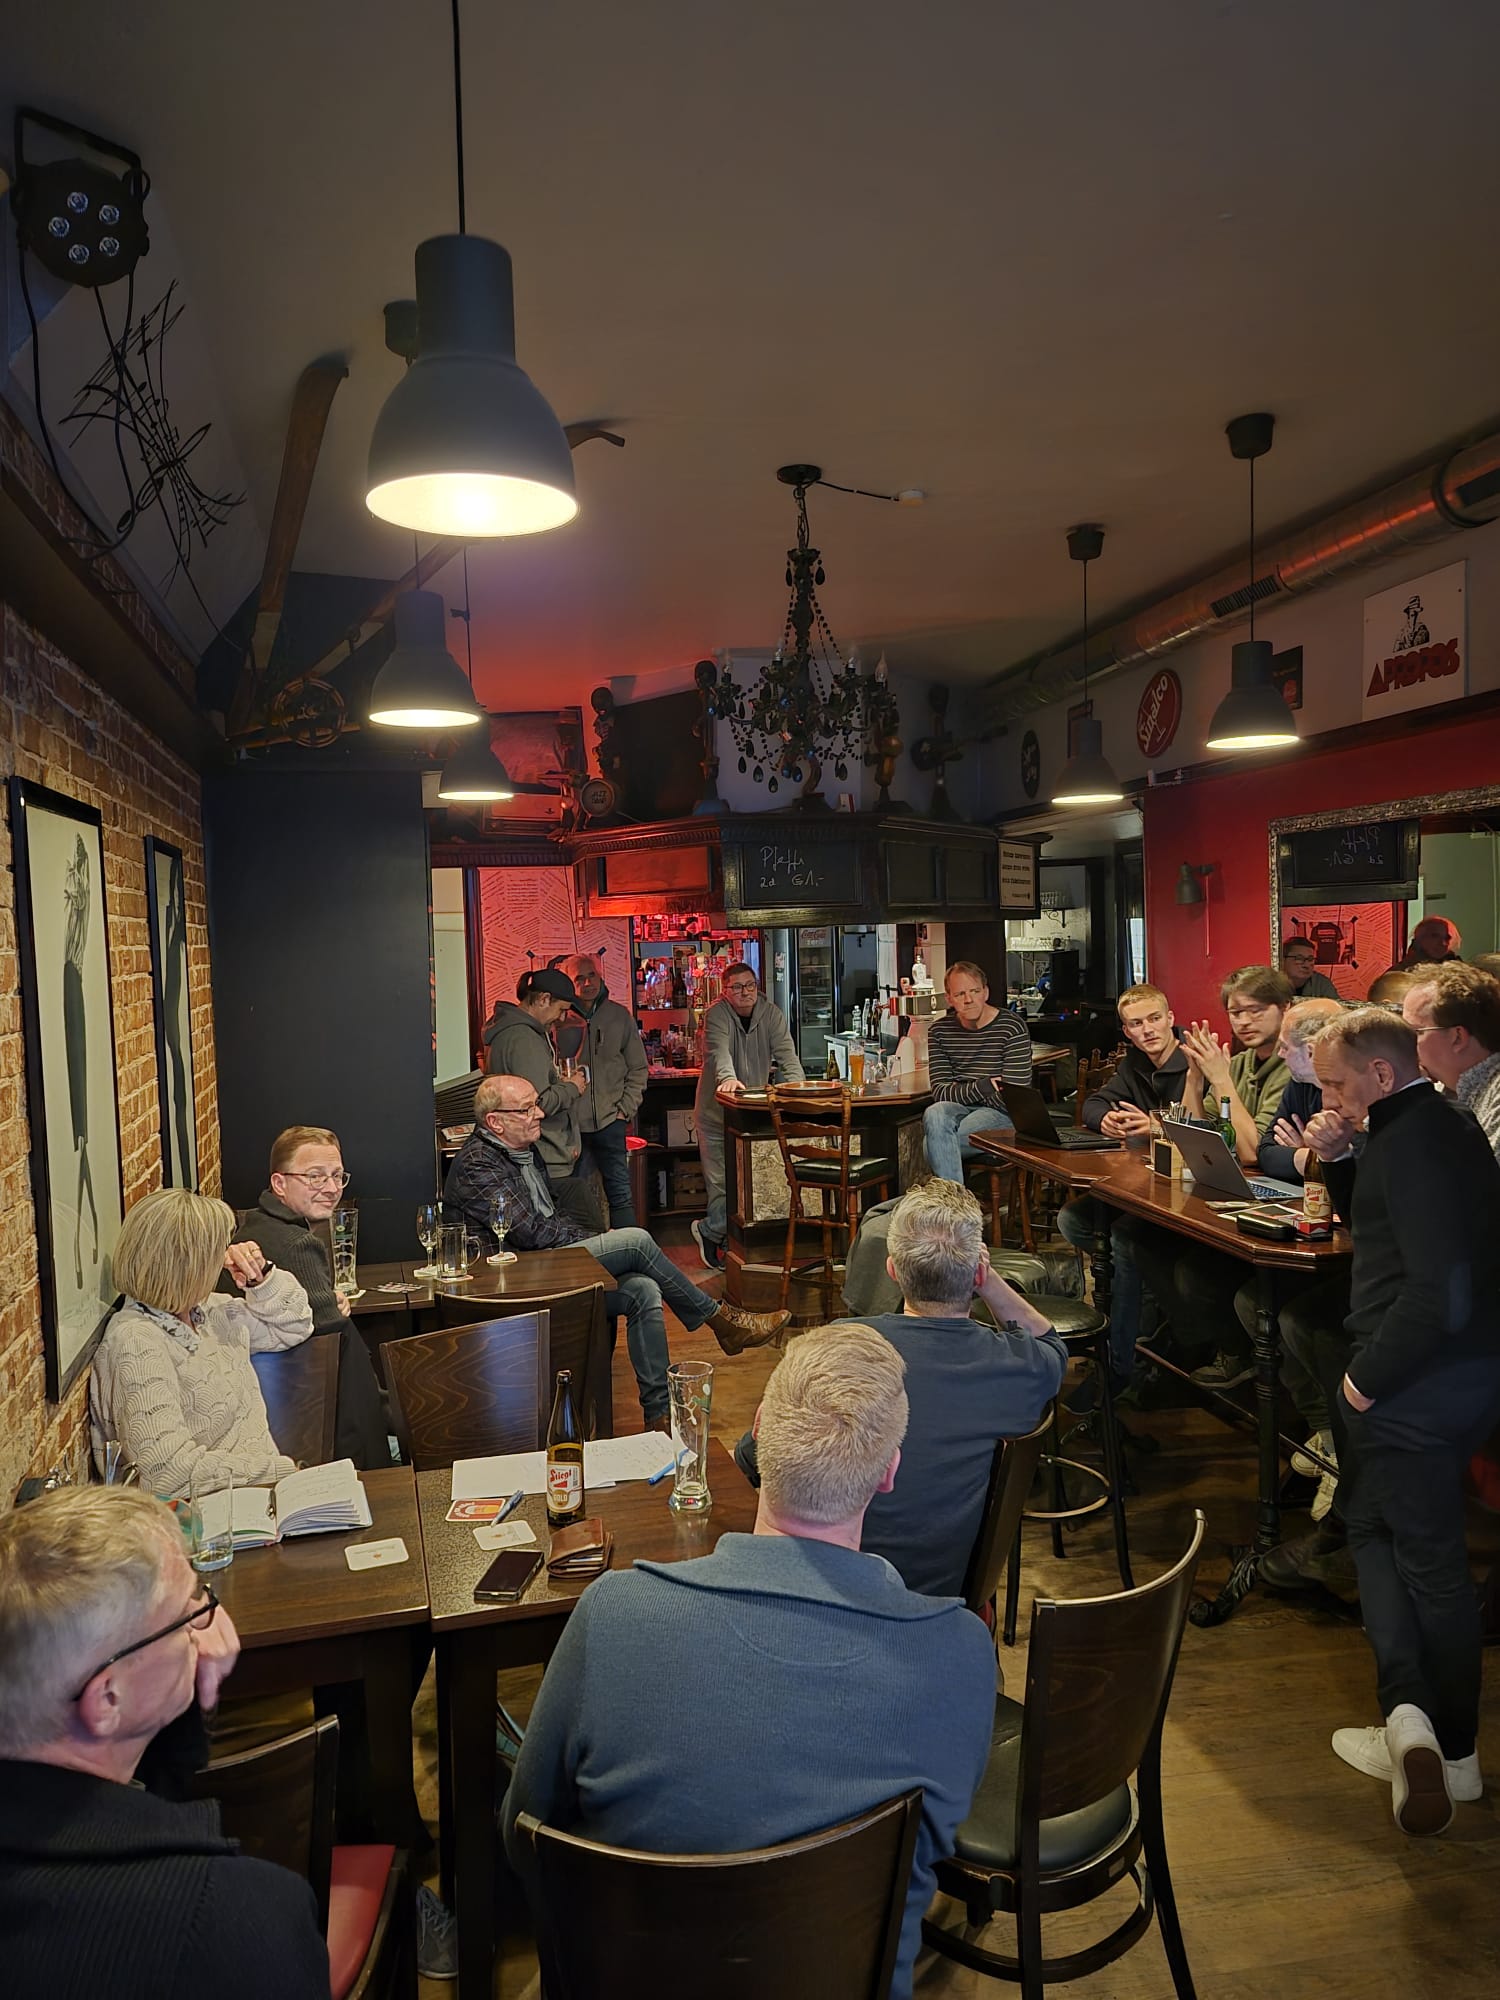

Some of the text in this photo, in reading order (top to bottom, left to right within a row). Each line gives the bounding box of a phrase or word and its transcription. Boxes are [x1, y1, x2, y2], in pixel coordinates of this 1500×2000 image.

[1366, 637, 1460, 698] APROPOS
[1137, 675, 1169, 753] Sinalco
[549, 1468, 572, 1483] Stiegl
